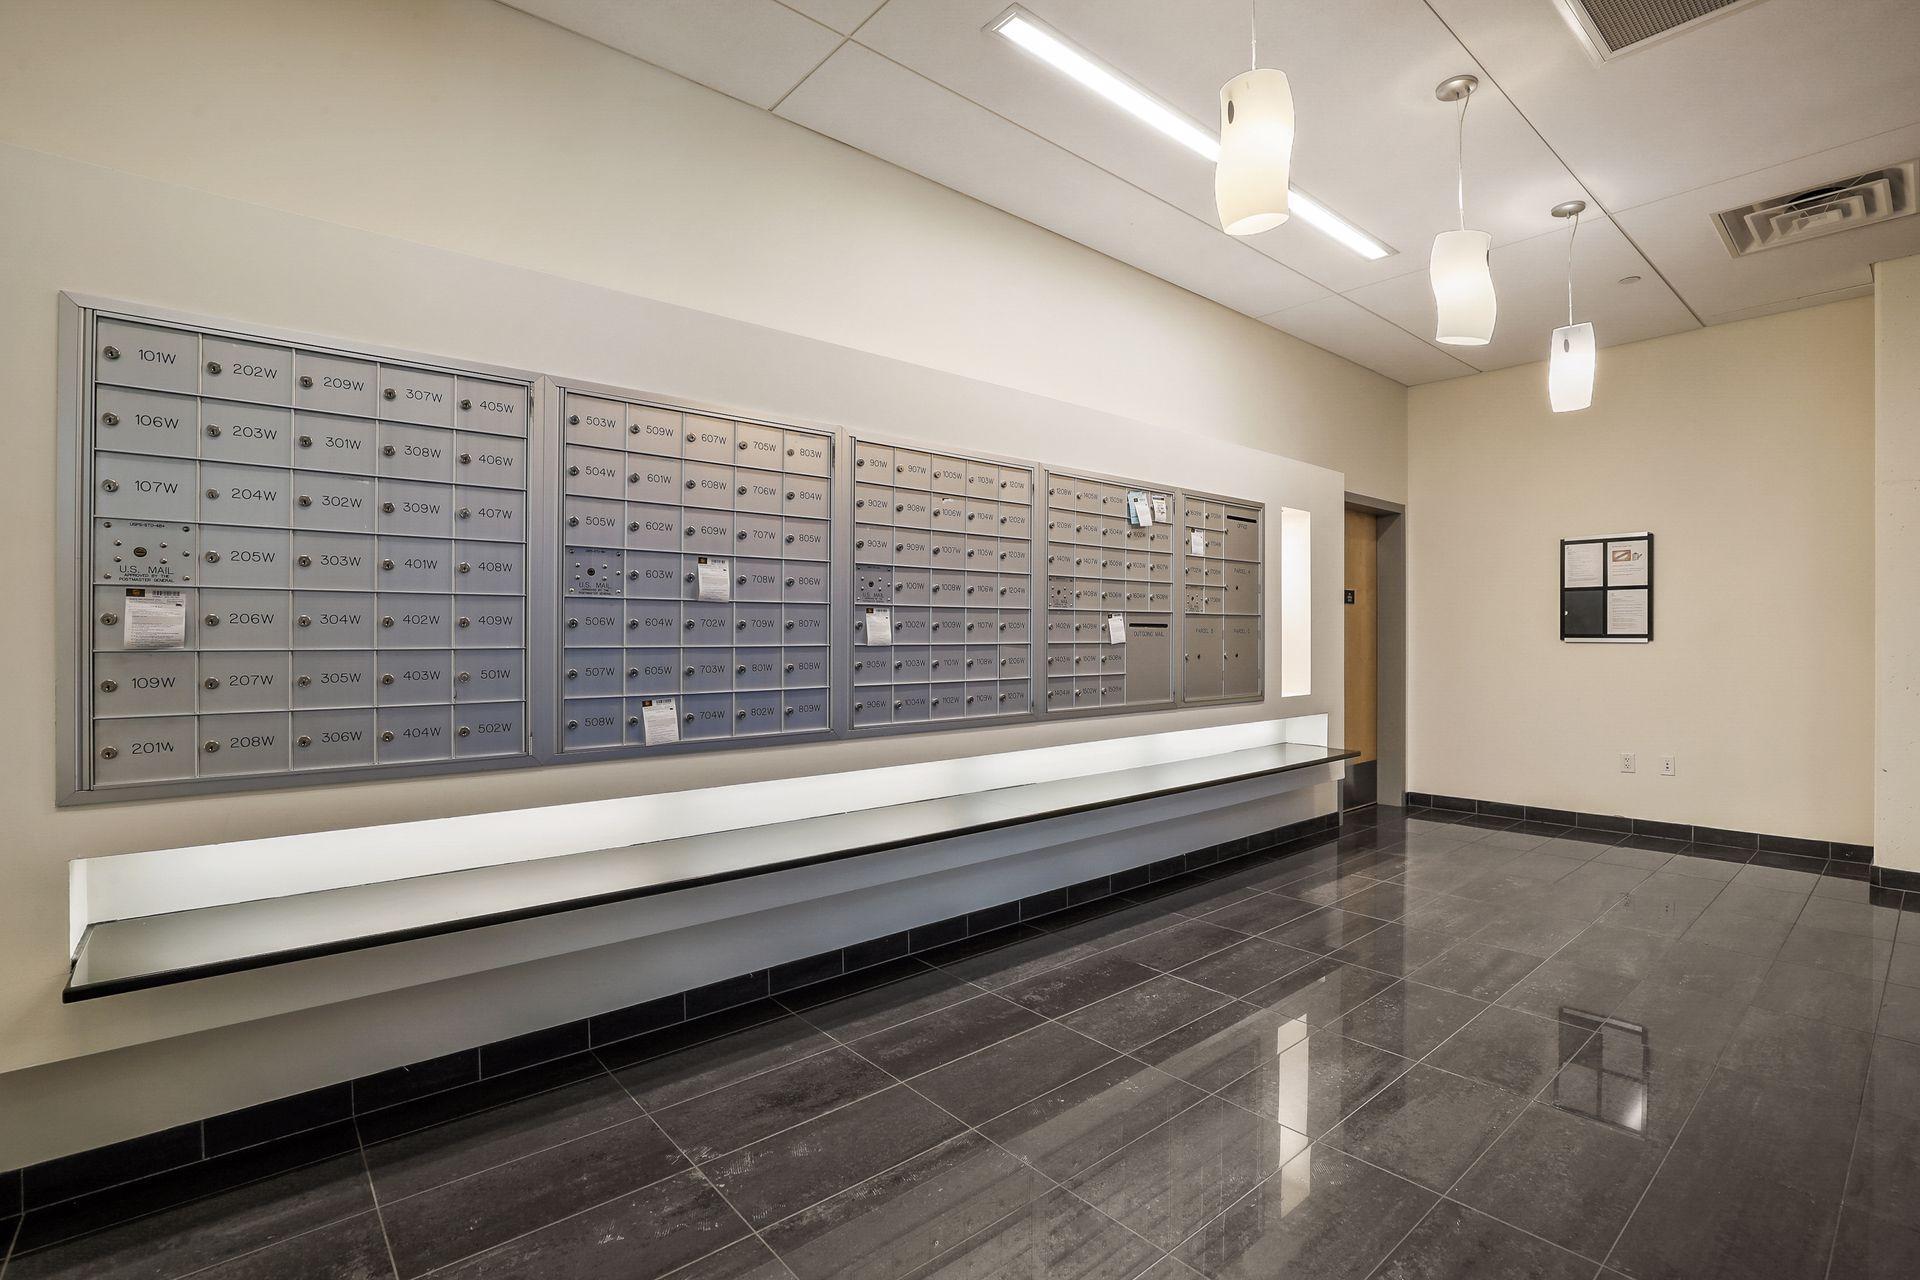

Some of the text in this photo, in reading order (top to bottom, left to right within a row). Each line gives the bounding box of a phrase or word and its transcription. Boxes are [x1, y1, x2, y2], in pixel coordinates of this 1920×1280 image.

[138, 348, 177, 366] 101W
[233, 363, 278, 380] 202W
[323, 376, 365, 393] 209W
[406, 388, 443, 404] 307W
[479, 400, 515, 414] 405W
[135, 413, 179, 430] 106W
[586, 414, 616, 429] 503W
[232, 425, 277, 440] 203W
[646, 425, 674, 438] 509W
[325, 436, 362, 450] 301W
[701, 434, 726, 445] 607W
[404, 445, 442, 460] 308W
[753, 441, 776, 453] 705W
[799, 448, 822, 459] 803W
[478, 454, 514, 467] 406W
[870, 458, 887, 468] 901W
[585, 465, 615, 478] 504W
[908, 464, 926, 475] 907W
[943, 470, 962, 480] 1005W
[647, 473, 672, 485] 601W
[978, 475, 994, 484] 1103W
[135, 480, 178, 495] 107W
[701, 480, 726, 491] 608W
[753, 485, 776, 496] 706W
[1010, 480, 1025, 490] 1201W
[231, 487, 277, 502] 204W
[799, 491, 822, 501] 804W
[321, 495, 363, 509] 302W
[868, 499, 888, 509] 902W
[907, 503, 926, 512] 908W
[402, 501, 441, 515] 309W
[477, 507, 513, 519] 407W
[942, 509, 961, 518] 1006W
[977, 512, 994, 520] 1104W
[1009, 516, 1025, 524] 1202W
[585, 516, 615, 528] 505W
[645, 521, 673, 532] 602W
[701, 526, 726, 536] 609W
[753, 530, 776, 540] 707W
[799, 534, 821, 544] 805W
[867, 540, 887, 549] 903W
[907, 543, 925, 552] 909W
[942, 546, 961, 554] 1007W
[977, 549, 993, 557] 1105W
[230, 550, 275, 564] 205W
[320, 554, 361, 568] 303W
[404, 558, 437, 570] 401W
[477, 561, 513, 573] 408W
[148, 566, 173, 574] MAIL
[645, 570, 673, 580] 603W
[751, 574, 776, 584] 708W
[798, 577, 821, 586] 806W
[906, 582, 925, 590] 1001W
[941, 584, 961, 592] 1008W
[977, 585, 994, 593] 1106W
[1008, 587, 1025, 595] 1204W
[229, 613, 274, 625] 206W
[319, 614, 361, 626] 304W
[402, 615, 440, 626] 402W
[478, 615, 513, 626] 409W
[585, 616, 615, 627] 506W
[645, 618, 673, 627] 604W
[701, 618, 726, 628] 702W
[751, 619, 775, 628] 709W
[798, 619, 820, 627] 807W
[752, 663, 773, 673] 801W
[798, 662, 820, 671] 808W
[866, 660, 886, 669] 905W
[905, 659, 925, 668] 1003W
[943, 659, 959, 667] 1101W
[480, 669, 511, 680] 501W
[585, 666, 615, 677] 507W
[644, 665, 672, 676] 605W
[700, 665, 725, 674] 703W
[229, 674, 274, 687] 207W
[320, 673, 361, 685] 305W
[402, 670, 441, 681] 403W
[131, 676, 176, 690] 109W
[942, 696, 960, 704] 1102W
[976, 694, 992, 702] 1109W
[1008, 692, 1024, 700] 1207W
[866, 700, 886, 709] 906W
[905, 697, 926, 707] 1004W
[751, 707, 774, 717] 802W
[798, 704, 821, 713] 809W
[700, 710, 725, 720] 704W
[584, 715, 615, 727] 508W
[403, 727, 442, 739] 404W
[477, 722, 512, 734] 502W
[230, 735, 274, 749] 208W
[321, 731, 362, 744] 306W
[131, 741, 175, 756] 201W
